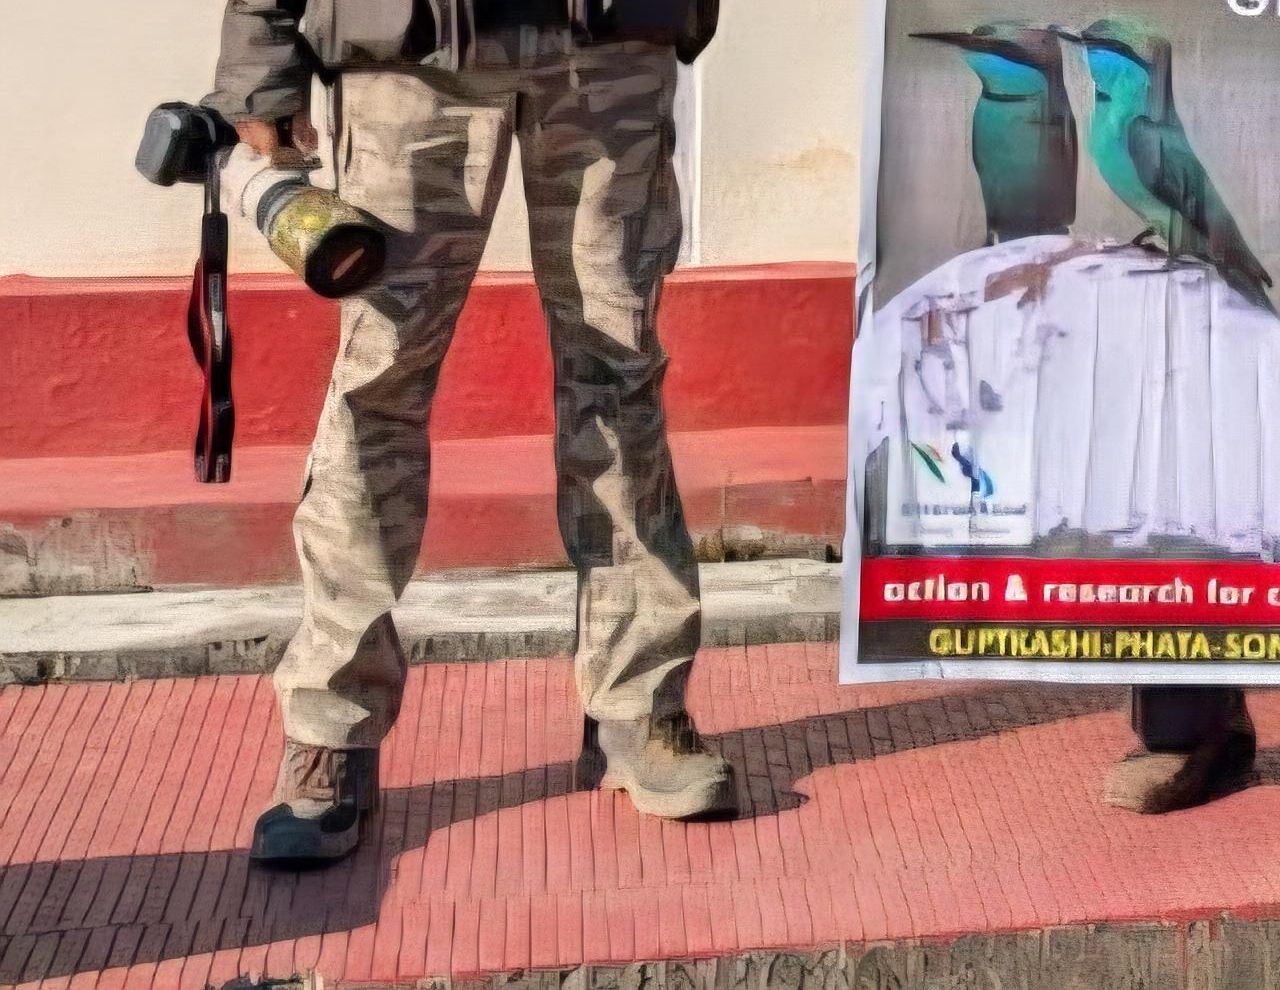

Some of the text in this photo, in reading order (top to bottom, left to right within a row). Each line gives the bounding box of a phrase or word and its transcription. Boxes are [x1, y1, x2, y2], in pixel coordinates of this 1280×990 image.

[884, 574, 990, 602] action
[1004, 573, 1028, 602] &
[1043, 577, 1194, 604] research
[1207, 577, 1255, 605] for
